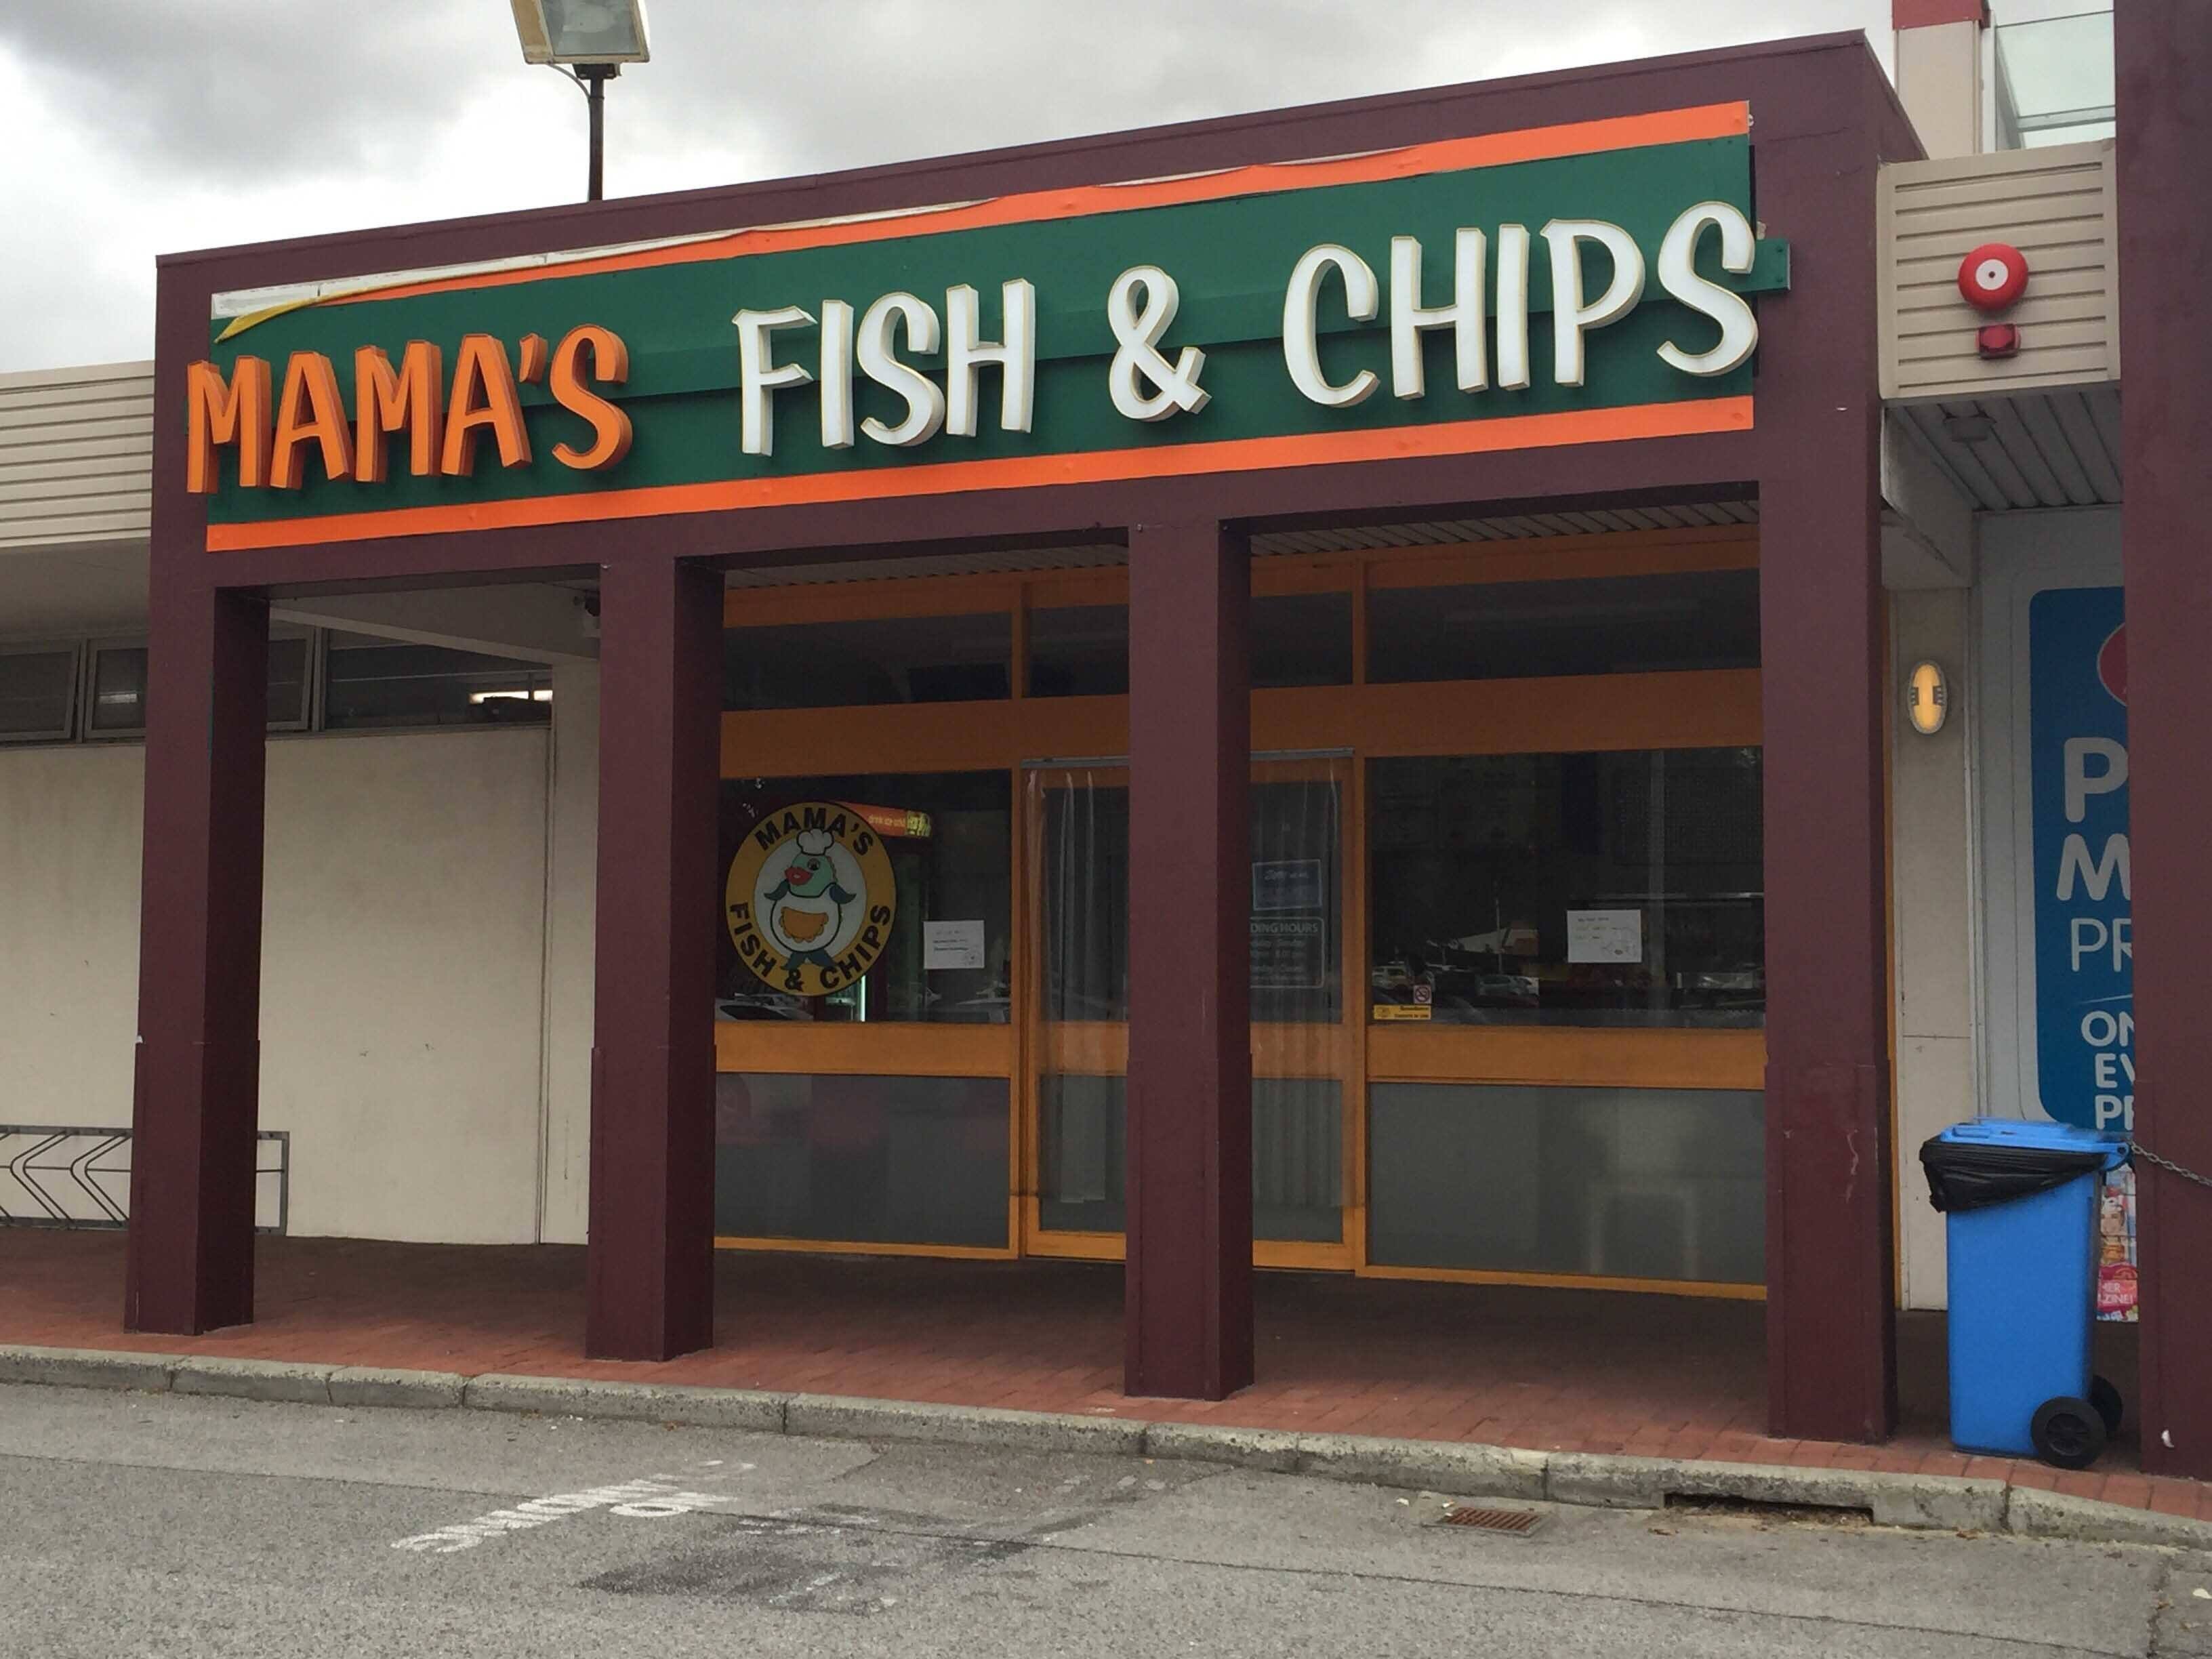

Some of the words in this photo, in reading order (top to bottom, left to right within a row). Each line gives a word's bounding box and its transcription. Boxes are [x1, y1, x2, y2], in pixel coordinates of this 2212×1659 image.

[186, 323, 633, 493] MAMA'S
[732, 278, 1036, 457] FISH
[1108, 264, 1212, 422] &
[1282, 201, 1759, 408] CHIPS
[754, 806, 874, 856] MAMA'S
[730, 901, 777, 978] FISH
[784, 968, 804, 991] &
[819, 905, 891, 989] CHIPS
[1280, 923, 1318, 933] HOURS
